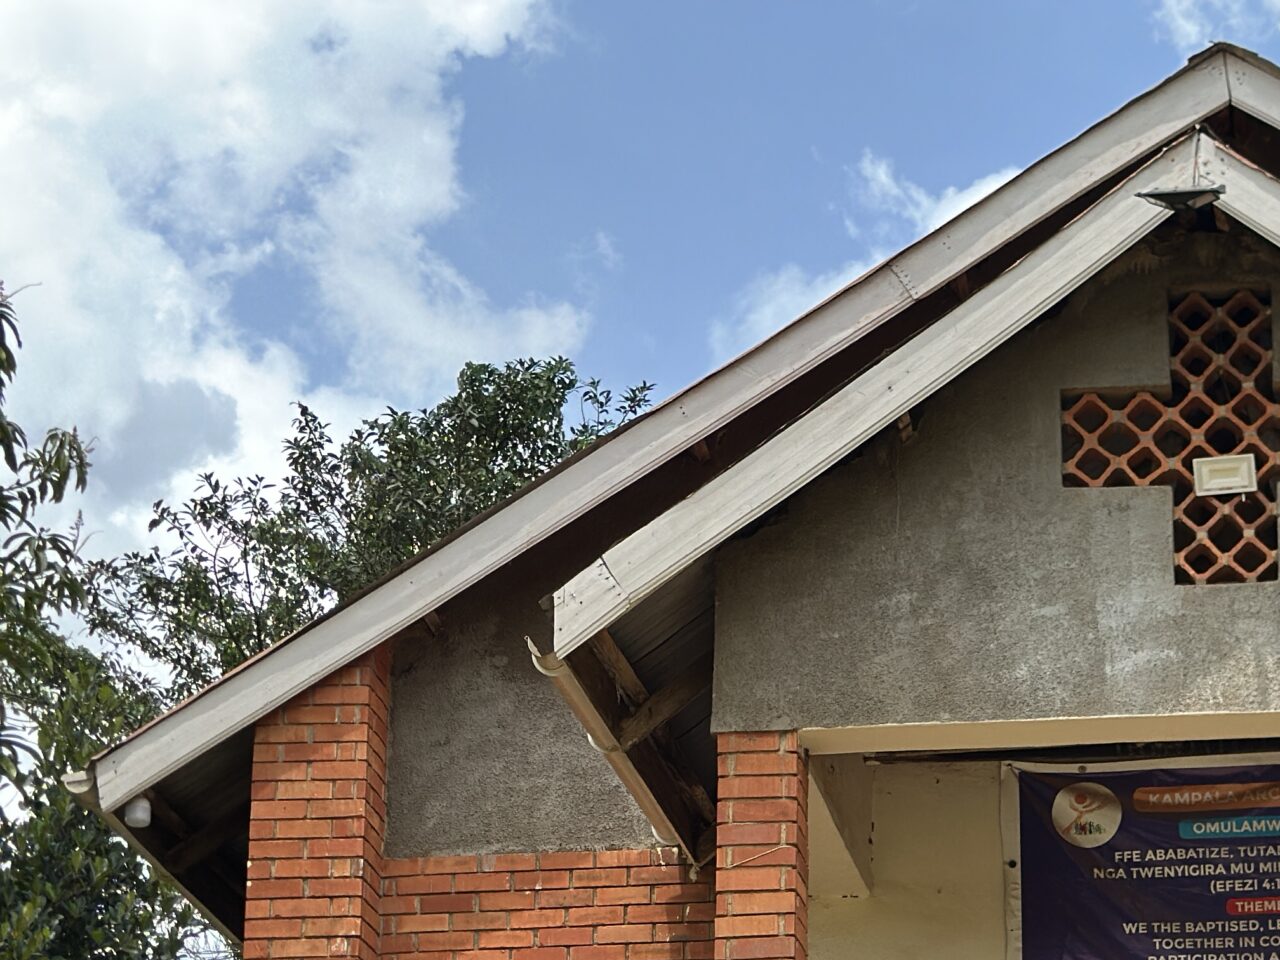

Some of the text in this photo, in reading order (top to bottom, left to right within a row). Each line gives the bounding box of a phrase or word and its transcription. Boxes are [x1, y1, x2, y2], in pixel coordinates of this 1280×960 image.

[1149, 790, 1236, 805] KAMPALA
[1114, 850, 1141, 862] FFE
[1093, 868, 1127, 879] NGA
[1130, 865, 1226, 879] TWENYIGIRA
[1230, 863, 1255, 874] MU
[1210, 880, 1258, 894] (EFEZI
[1123, 923, 1148, 934] WE
[1151, 922, 1181, 933] THE
[1185, 919, 1264, 933] BAPTISED,
[1152, 937, 1234, 950] TOGETHER
[1239, 936, 1255, 948] IN
